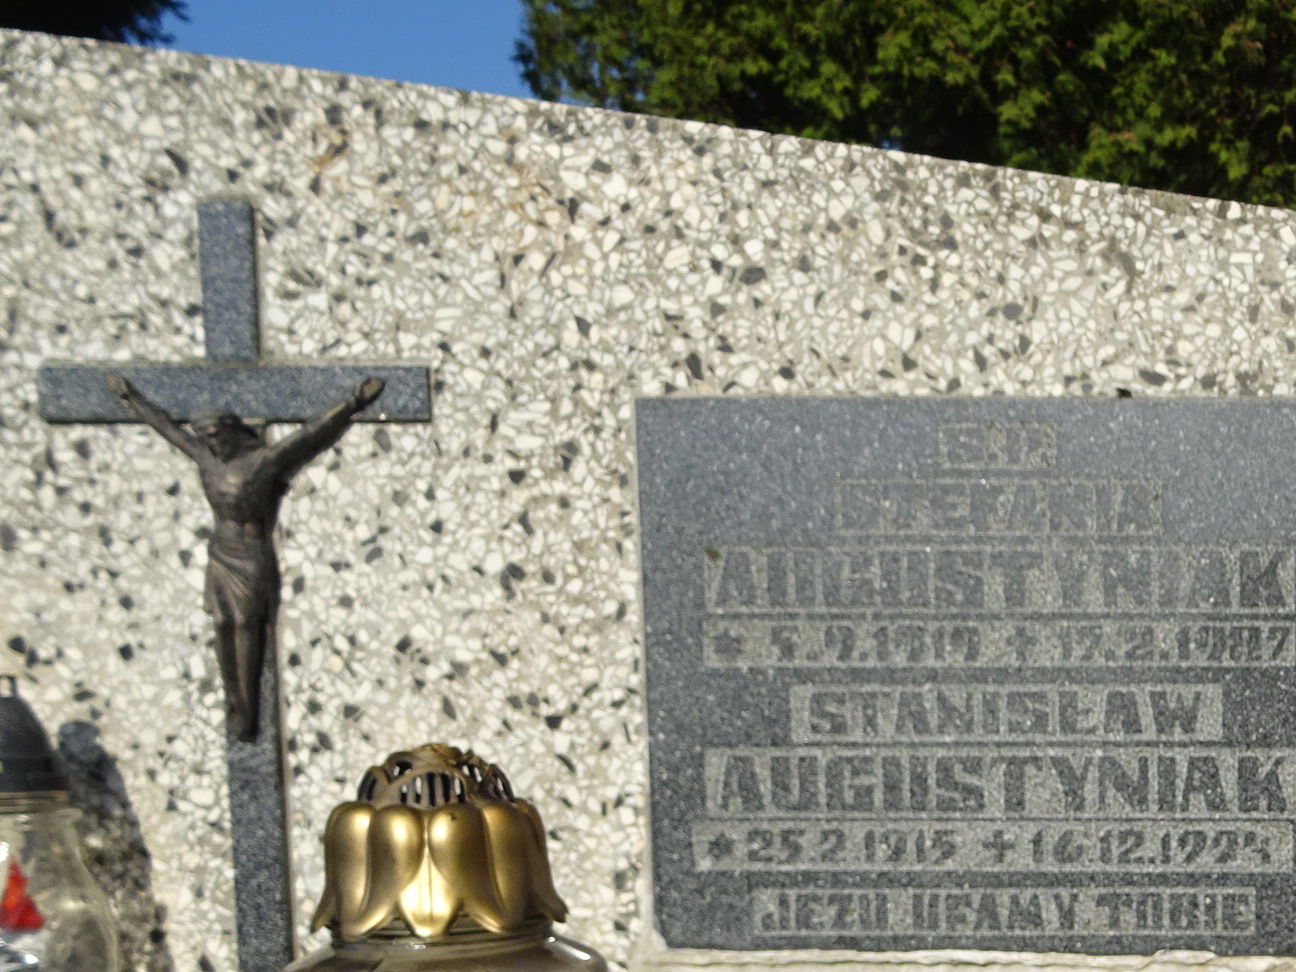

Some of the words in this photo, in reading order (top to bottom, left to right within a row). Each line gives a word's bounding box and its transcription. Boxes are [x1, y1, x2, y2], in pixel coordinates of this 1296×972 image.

[714, 550, 1288, 609] AUGUSTYNIAK
[807, 690, 1199, 736] STANISŁAW
[720, 754, 1288, 812] AUGUSTYNIAK
[761, 892, 889, 931] JEZU
[911, 892, 1080, 931] UFAMY
[1096, 892, 1252, 931] TOBIE
